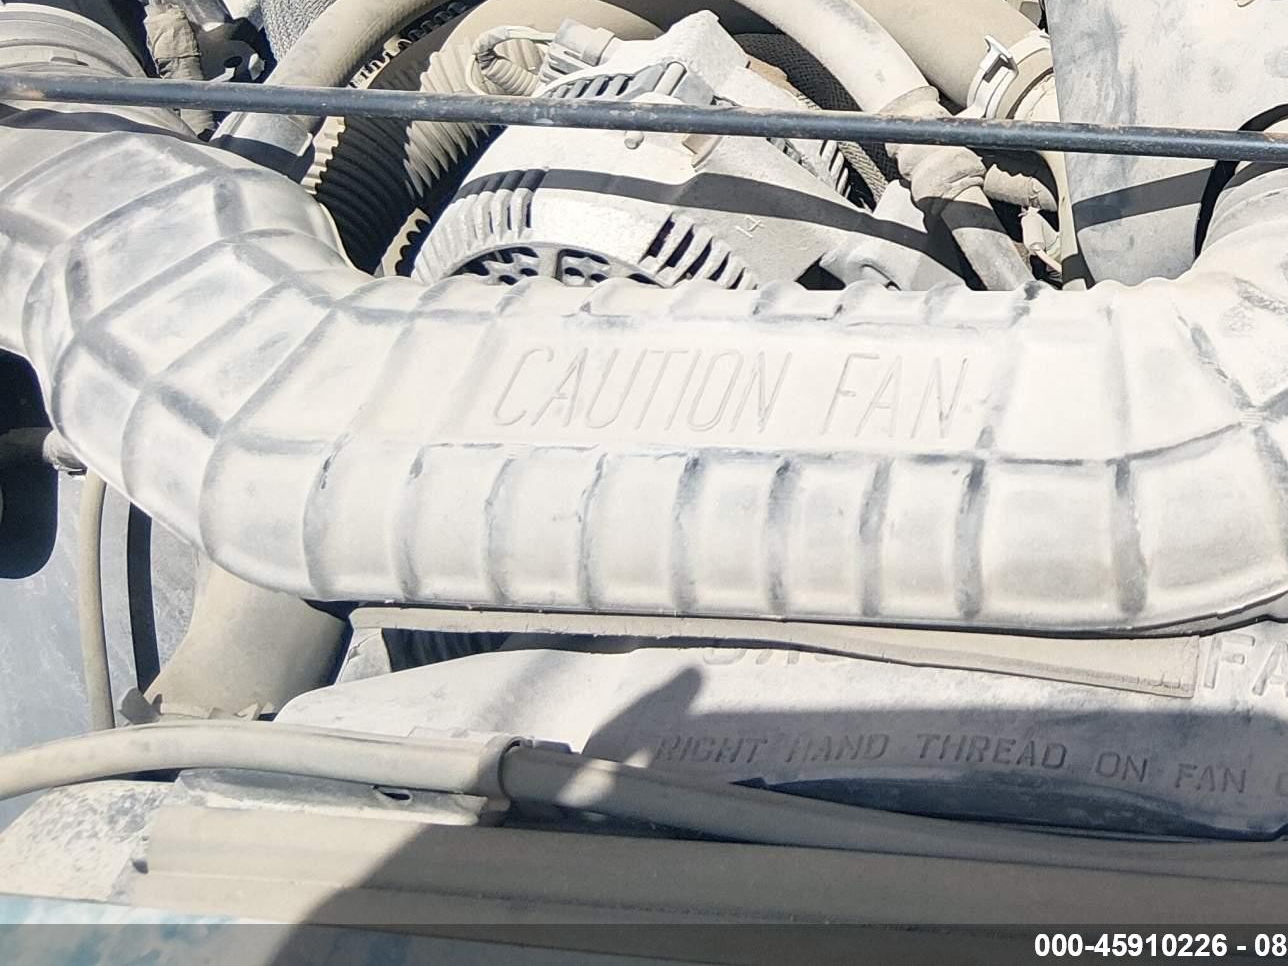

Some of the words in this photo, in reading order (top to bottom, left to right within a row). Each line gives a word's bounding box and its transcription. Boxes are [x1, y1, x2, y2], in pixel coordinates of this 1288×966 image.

[492, 345, 793, 434] CAUTION
[821, 351, 968, 439] FAN
[654, 735, 767, 764] RIGHT
[785, 733, 890, 762] HAND
[916, 732, 1067, 770] THREAD
[1095, 751, 1148, 783] ON
[1174, 763, 1247, 794] FAN
